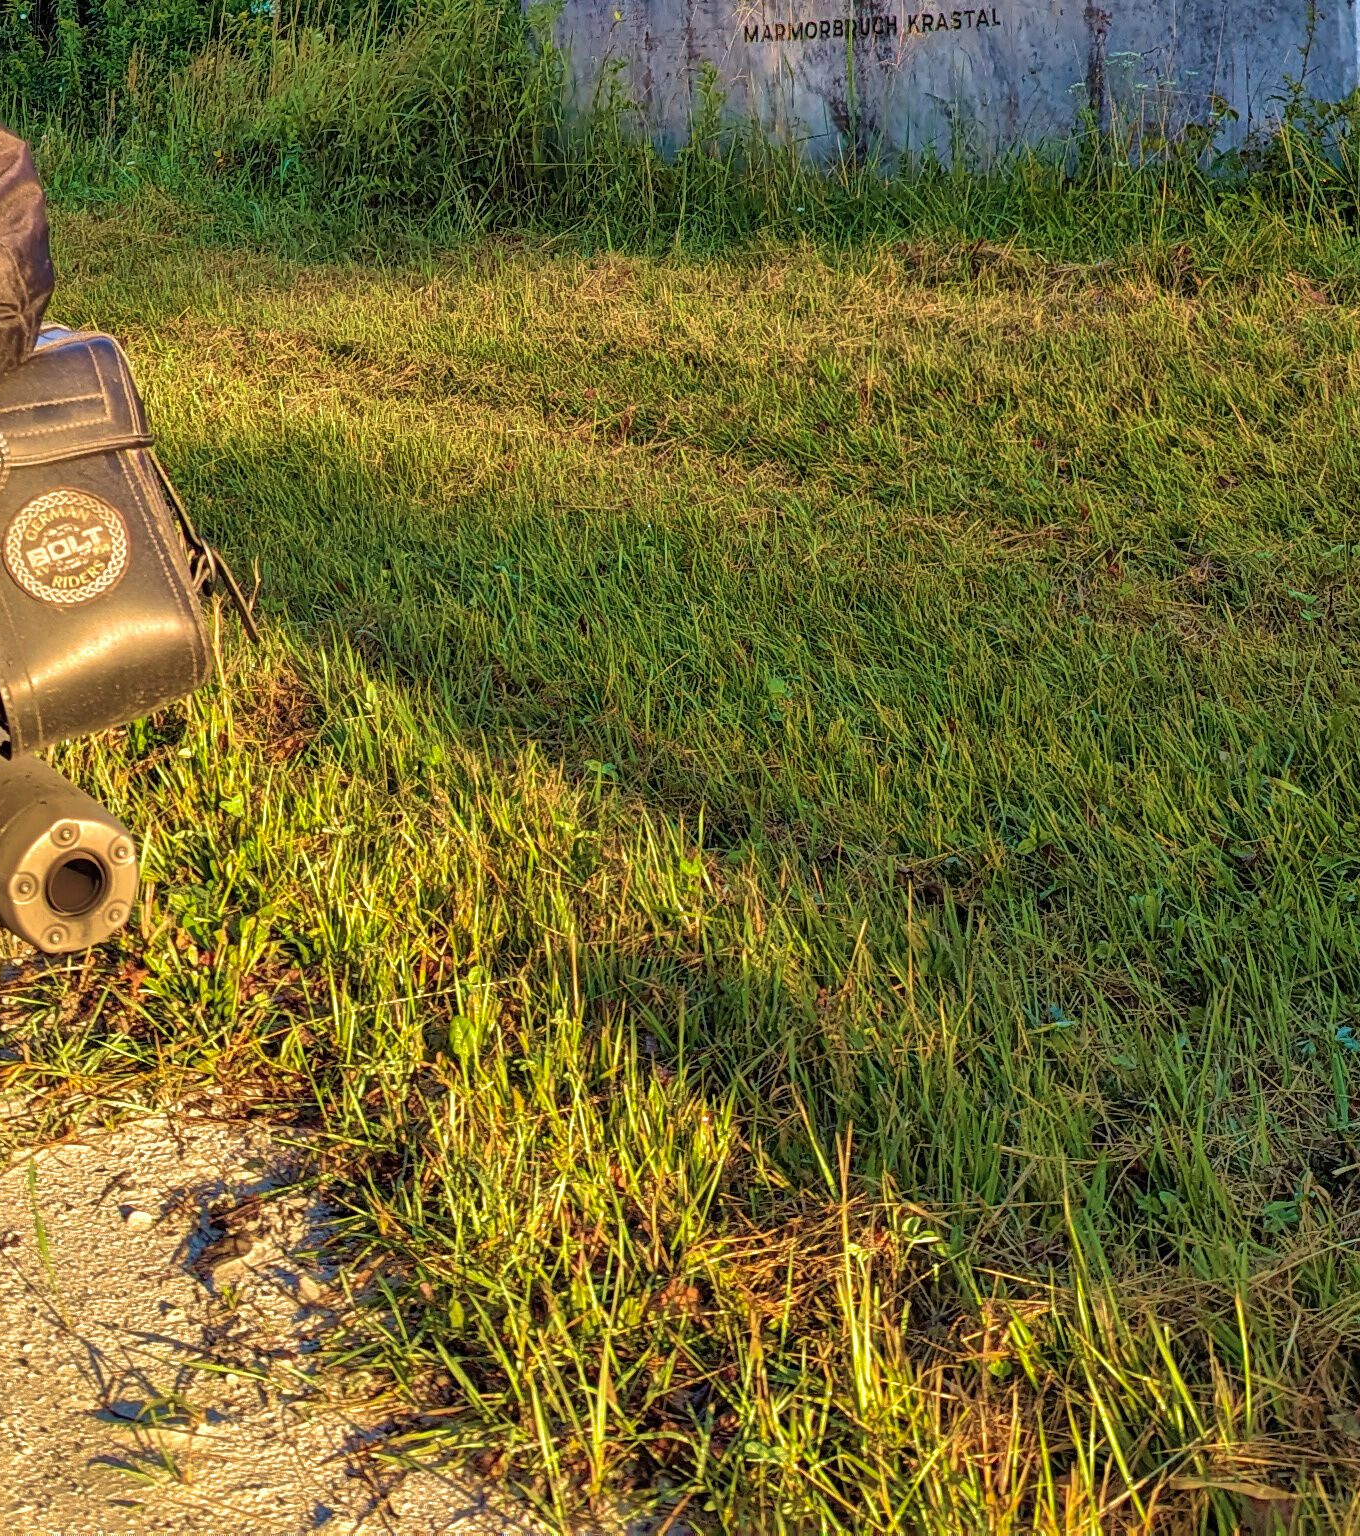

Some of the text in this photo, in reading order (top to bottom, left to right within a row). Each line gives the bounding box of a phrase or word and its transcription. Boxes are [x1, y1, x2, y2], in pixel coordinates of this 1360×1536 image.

[744, 8, 1001, 43] MARMORBRUCH KRASTAL
[26, 526, 103, 568] BOLT
[51, 560, 106, 588] RIDERS
